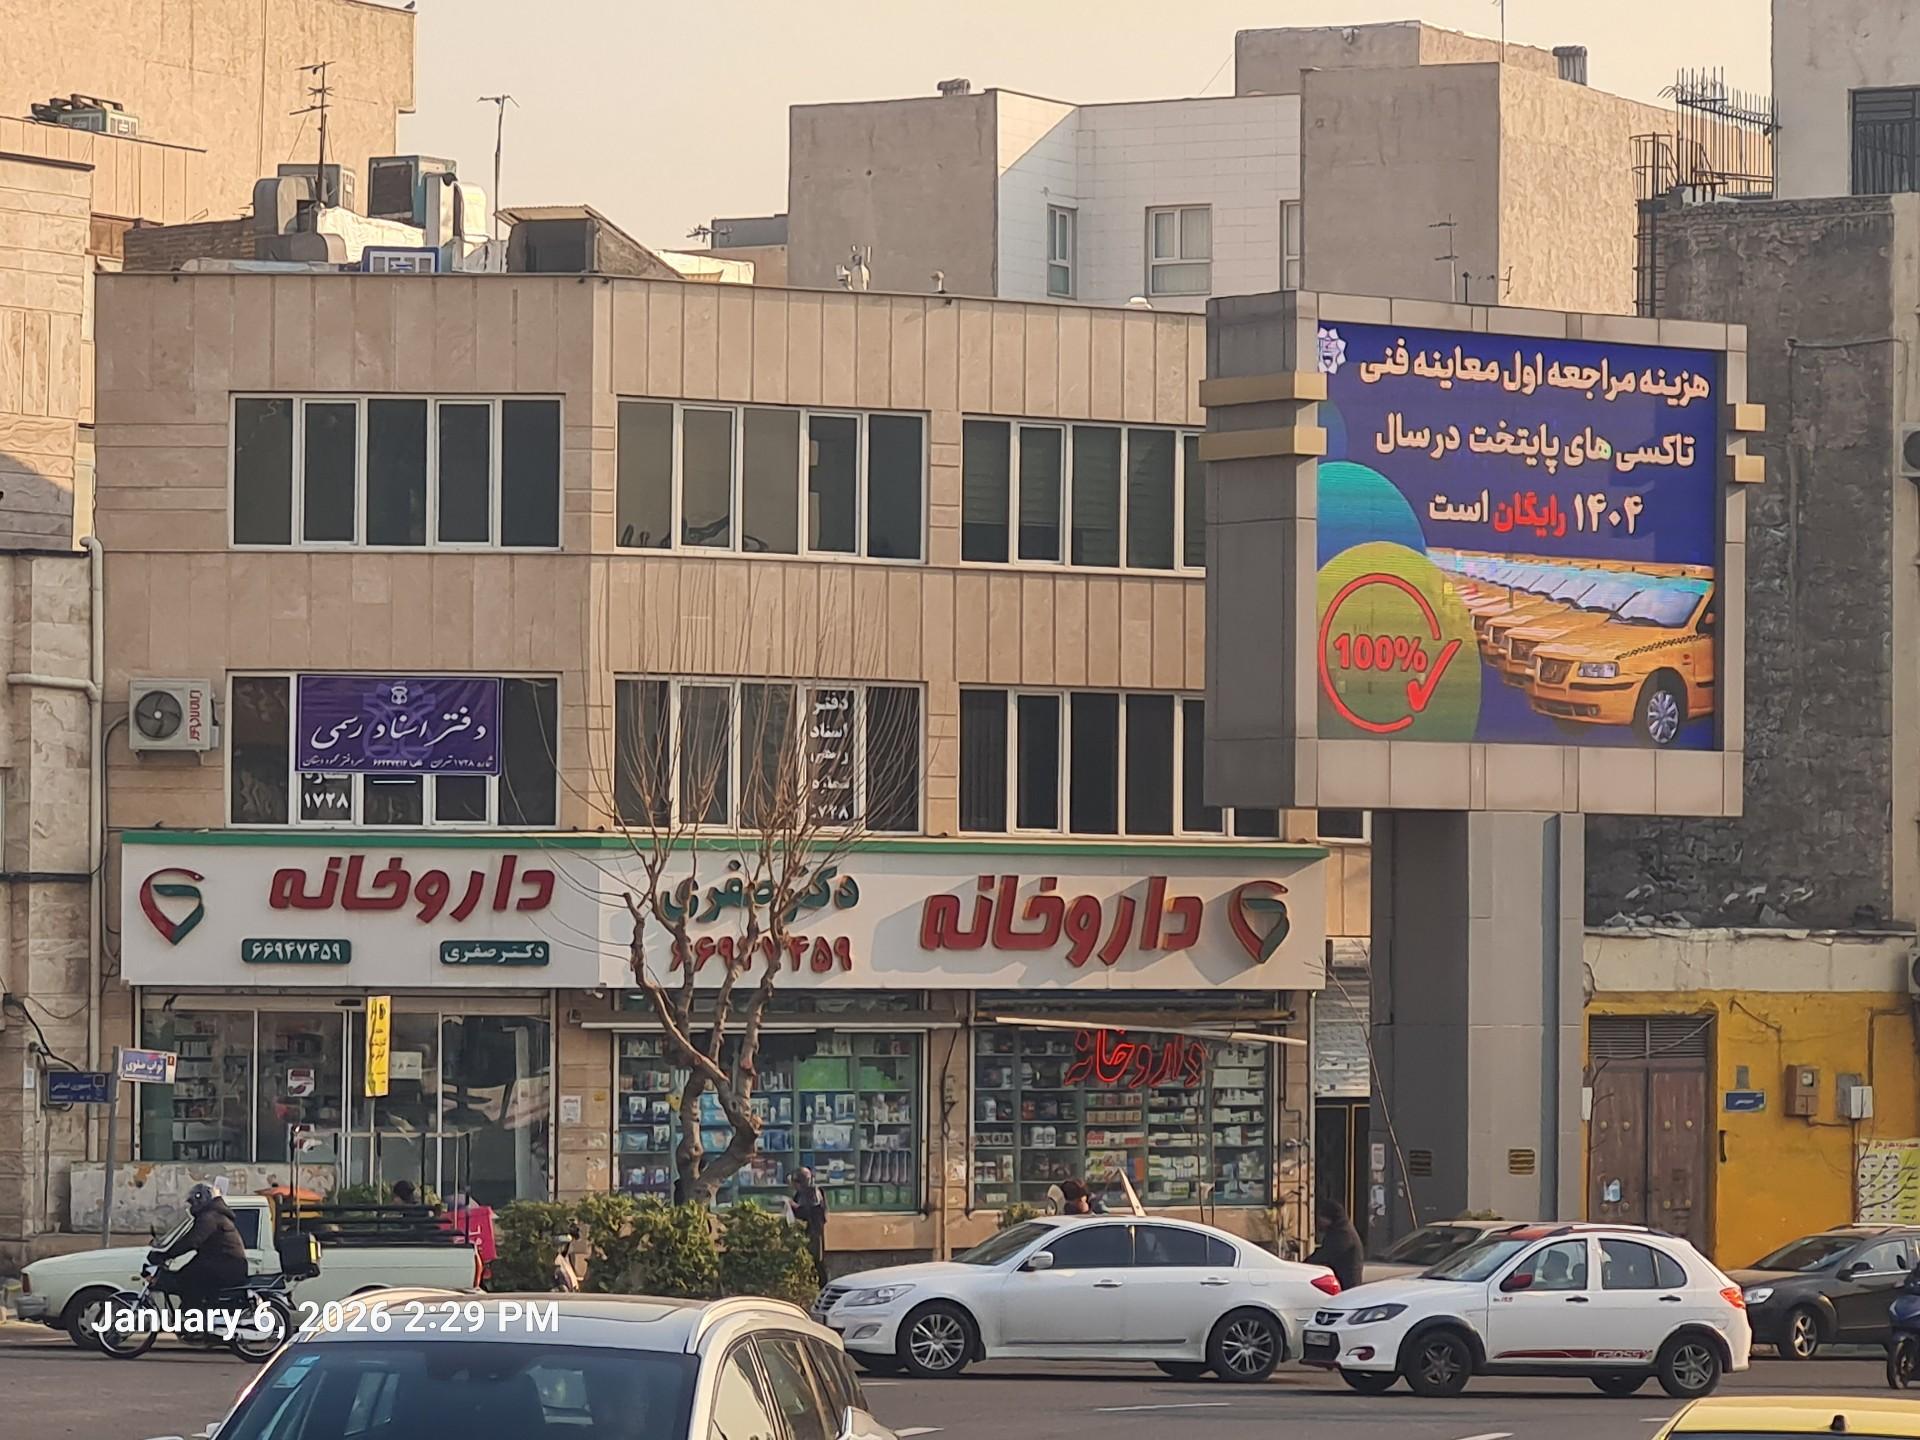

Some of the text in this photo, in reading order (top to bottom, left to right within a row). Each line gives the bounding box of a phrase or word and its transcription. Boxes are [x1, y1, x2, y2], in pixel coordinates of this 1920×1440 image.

[1360, 337, 1710, 407] هزینه مراجعه اول معاینه فنی
[1375, 412, 1696, 475] تاکسی های پایتخت در سال
[1428, 488, 1645, 539] ۱۴۰۴ رایگان است
[1333, 632, 1429, 673] 100%
[812, 692, 849, 715] دفتر
[310, 706, 487, 750] دفتر اسناد رسمی
[810, 722, 848, 738] اسناد
[304, 792, 349, 809] ۱۷۲۸
[269, 854, 556, 924] داروخانه
[919, 874, 1204, 968] داروخانه
[251, 941, 341, 961] ۶۶۹۴۷۴۵۹
[444, 943, 545, 963] دکتر صفری
